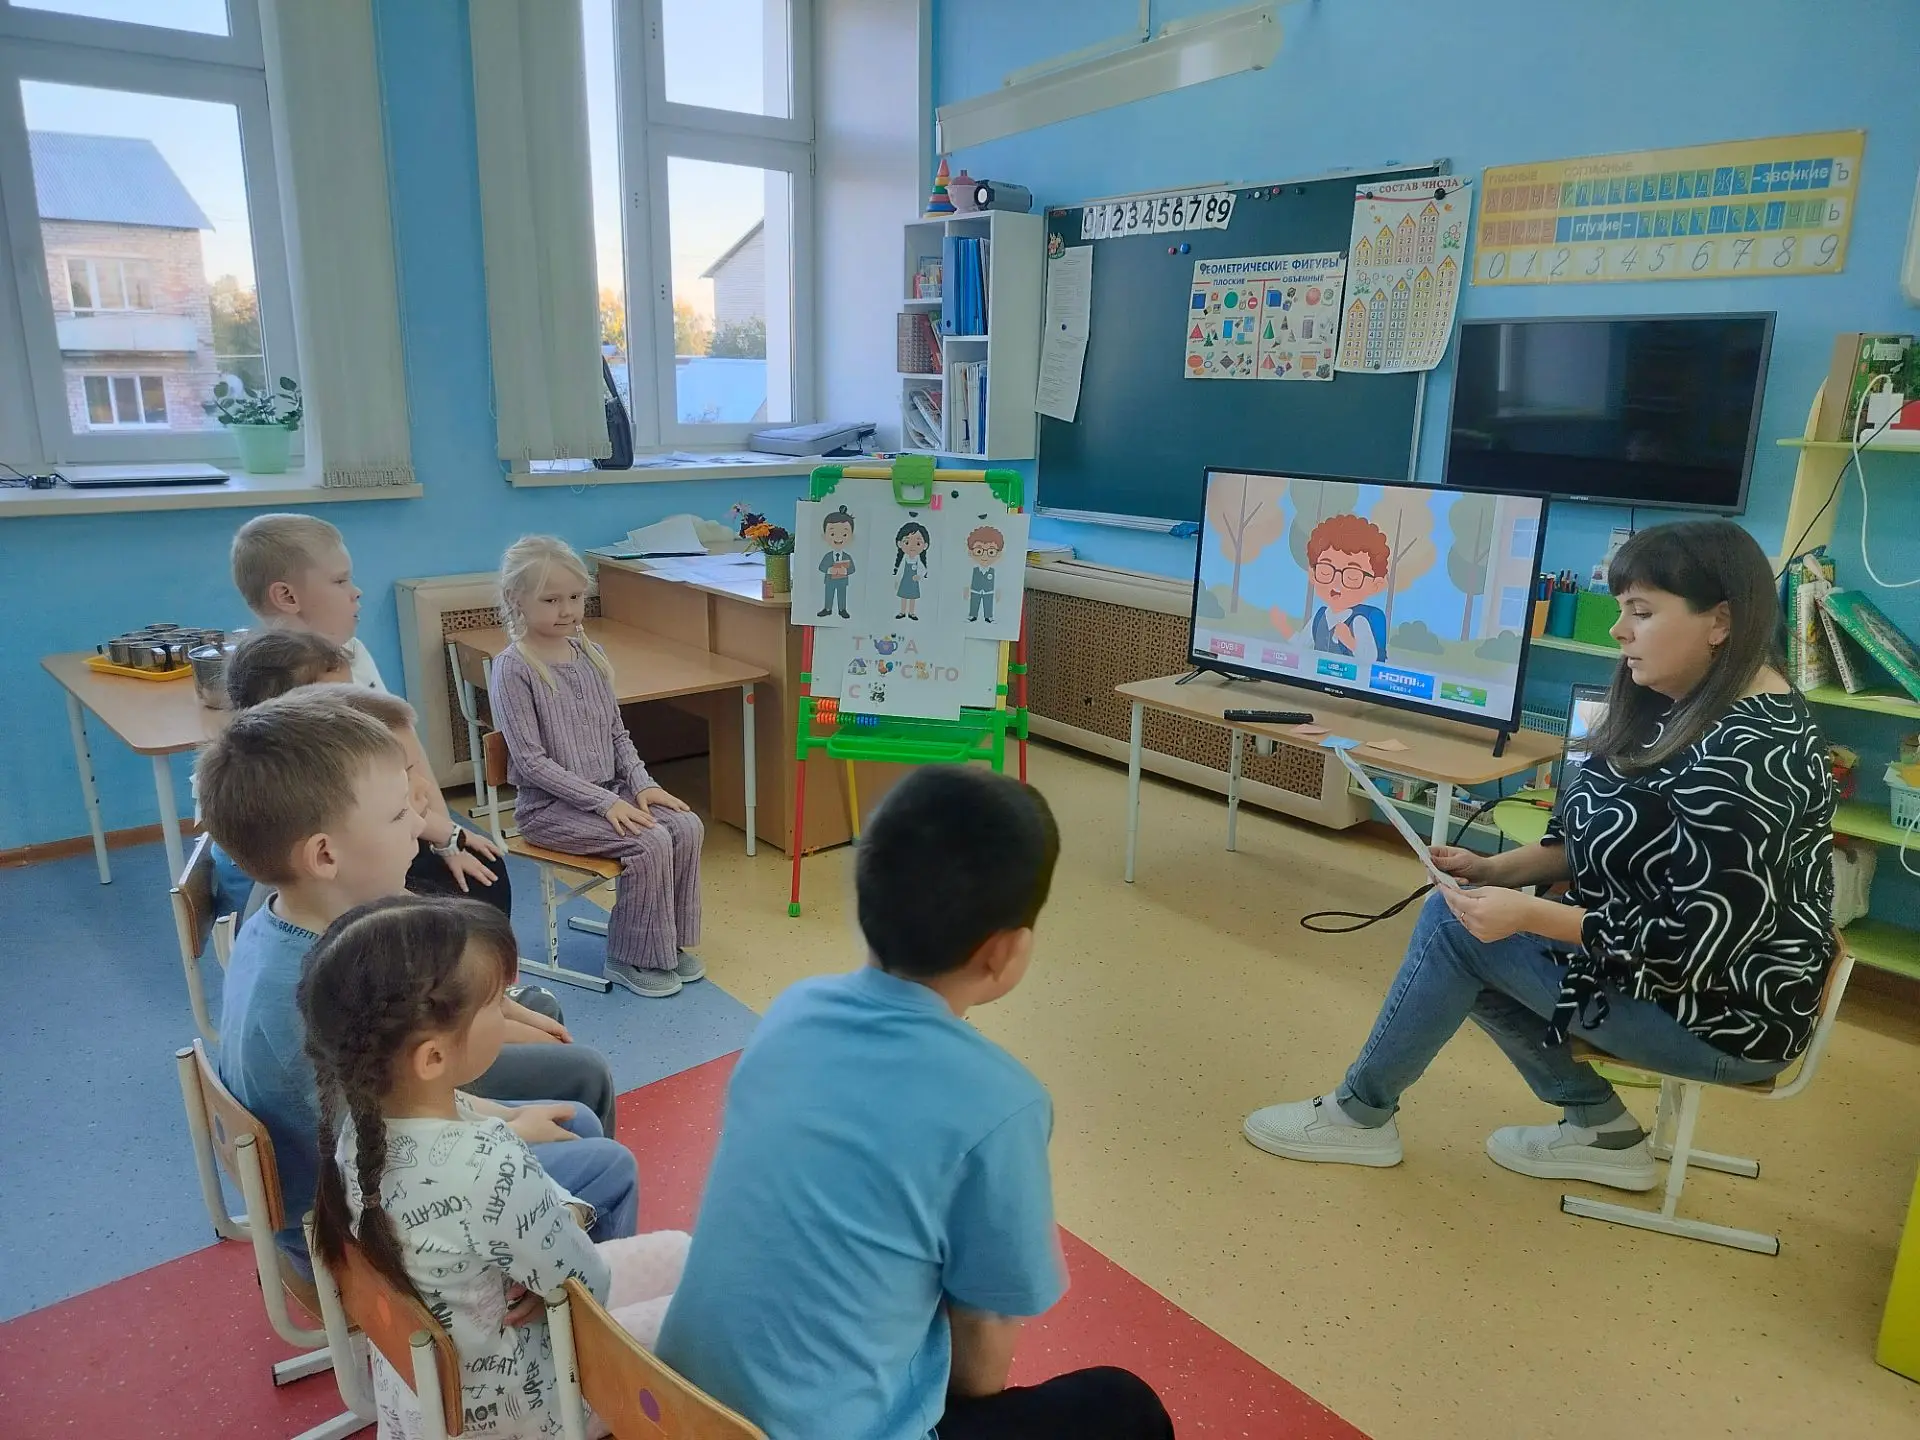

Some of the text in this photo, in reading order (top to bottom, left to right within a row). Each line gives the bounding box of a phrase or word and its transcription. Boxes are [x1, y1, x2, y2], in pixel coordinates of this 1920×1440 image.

[1489, 161, 1635, 186] ГЛАСНЫЕ СОГЛАСНЫЕ
[1836, 162, 1849, 182] Ъ
[1379, 182, 1418, 193] СОСТАВ
[1422, 179, 1459, 189] ЧИСЛА
[1829, 203, 1840, 221] Ь
[1291, 258, 1339, 270] ФИГУРЫ
[1488, 234, 1839, 279] 0 1 2 3 4 5 6 7 8 9
[852, 636, 918, 654] Т А
[901, 664, 913, 679] С
[848, 684, 861, 699] С
[522, 1358, 544, 1410] SUPER
[465, 1402, 498, 1424] LOV
